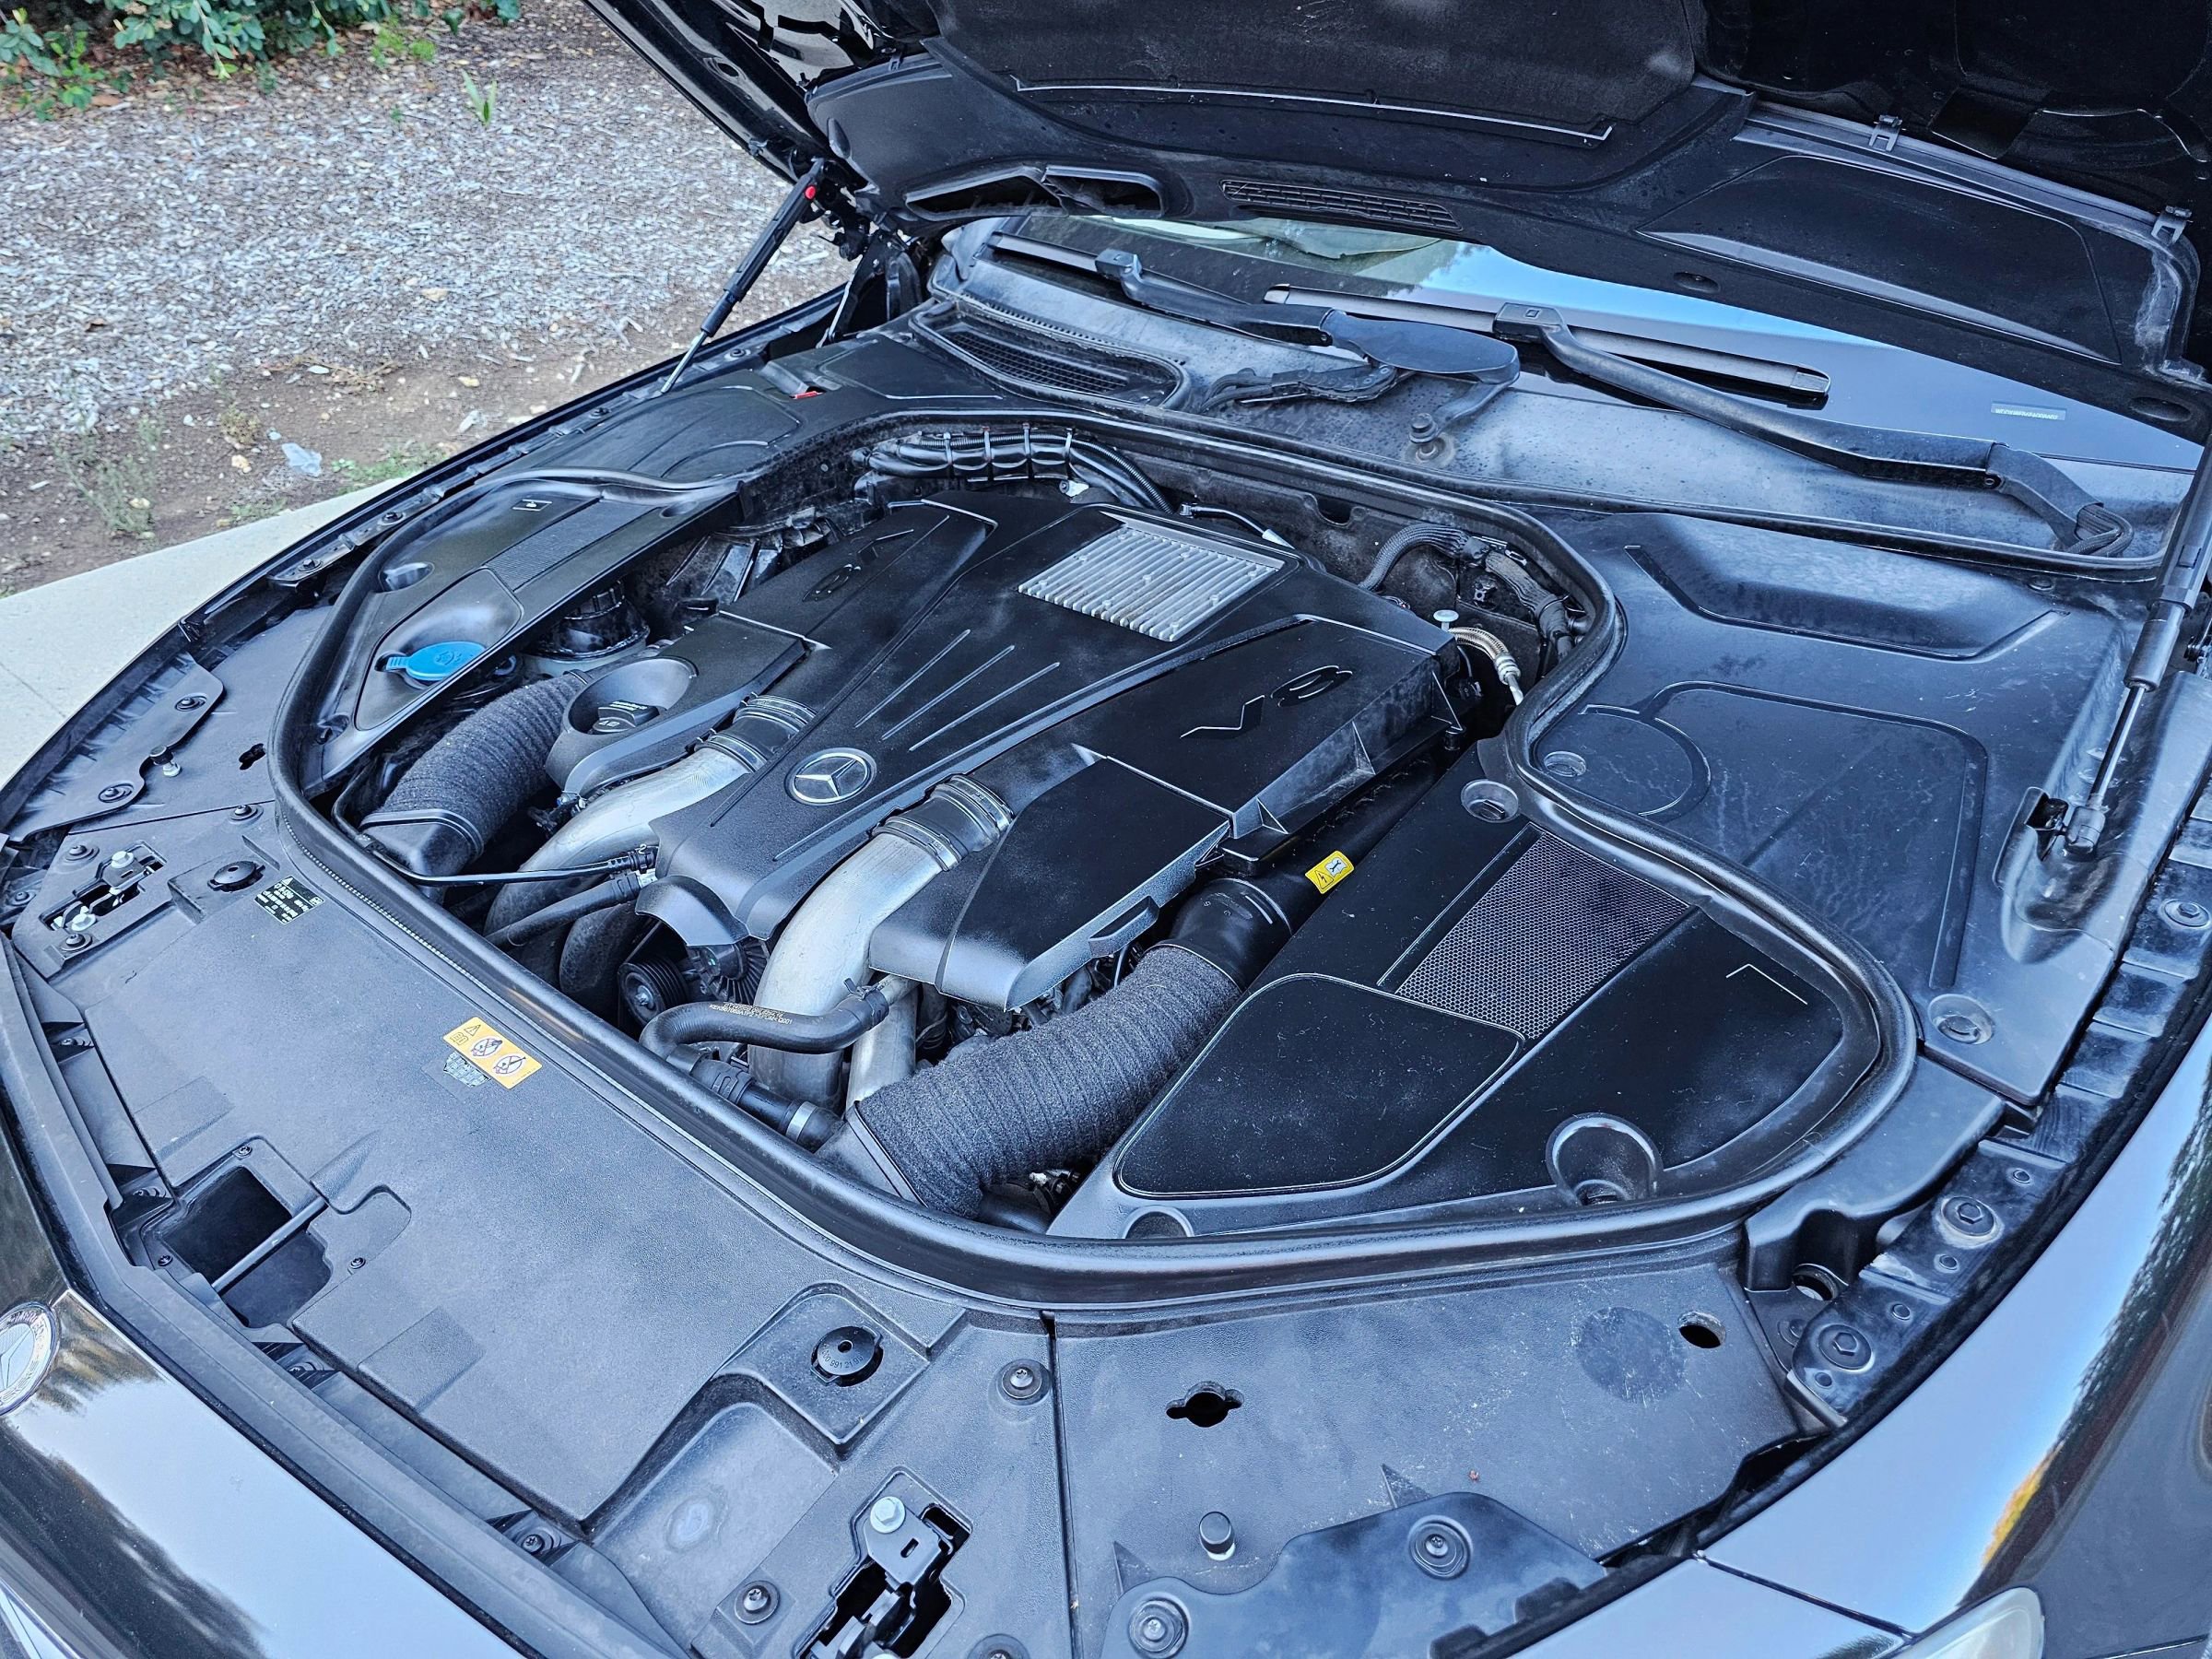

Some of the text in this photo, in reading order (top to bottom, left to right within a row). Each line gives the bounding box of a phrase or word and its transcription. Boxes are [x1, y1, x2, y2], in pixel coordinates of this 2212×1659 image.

[801, 528, 914, 603] V8
[1179, 665, 1354, 740] V8
[830, 1359, 842, 1369] 991
